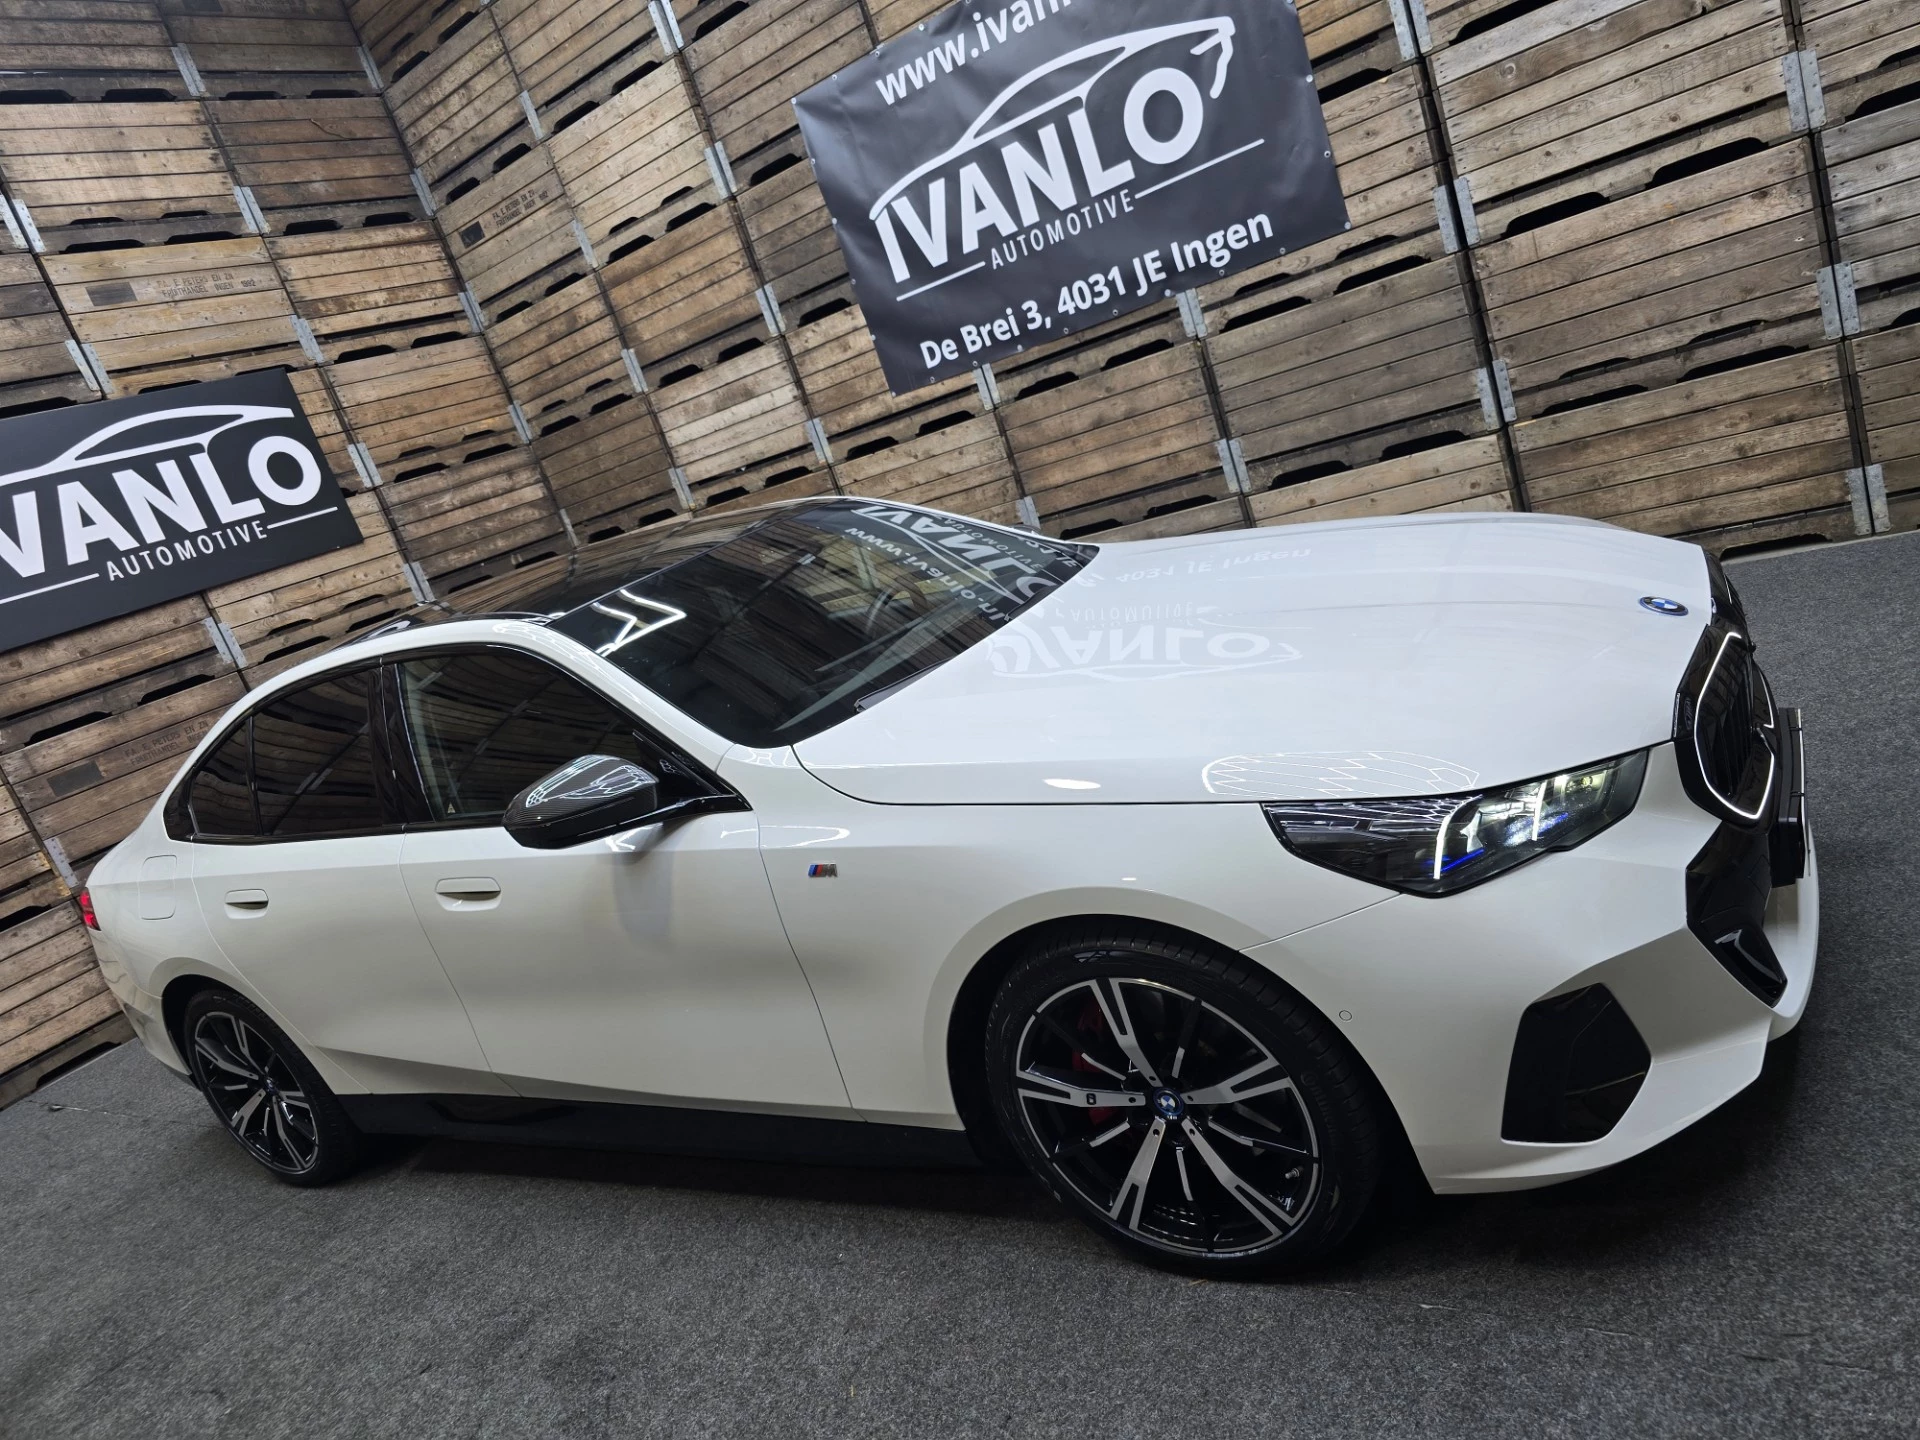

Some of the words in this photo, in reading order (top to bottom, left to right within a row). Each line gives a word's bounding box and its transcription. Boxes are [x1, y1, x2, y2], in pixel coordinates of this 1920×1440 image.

[875, 0, 1071, 106] www.ivan
[874, 67, 1204, 284] IVANLO
[990, 189, 1134, 270] AUTOMOTIVE
[920, 338, 959, 369] De
[960, 307, 1020, 354] Brei
[1022, 300, 1051, 329] 3,
[1057, 266, 1126, 315] 4031
[1133, 250, 1167, 297] JE
[1170, 212, 1274, 269] Ingen
[106, 520, 268, 581] AUTOMOTIVE
